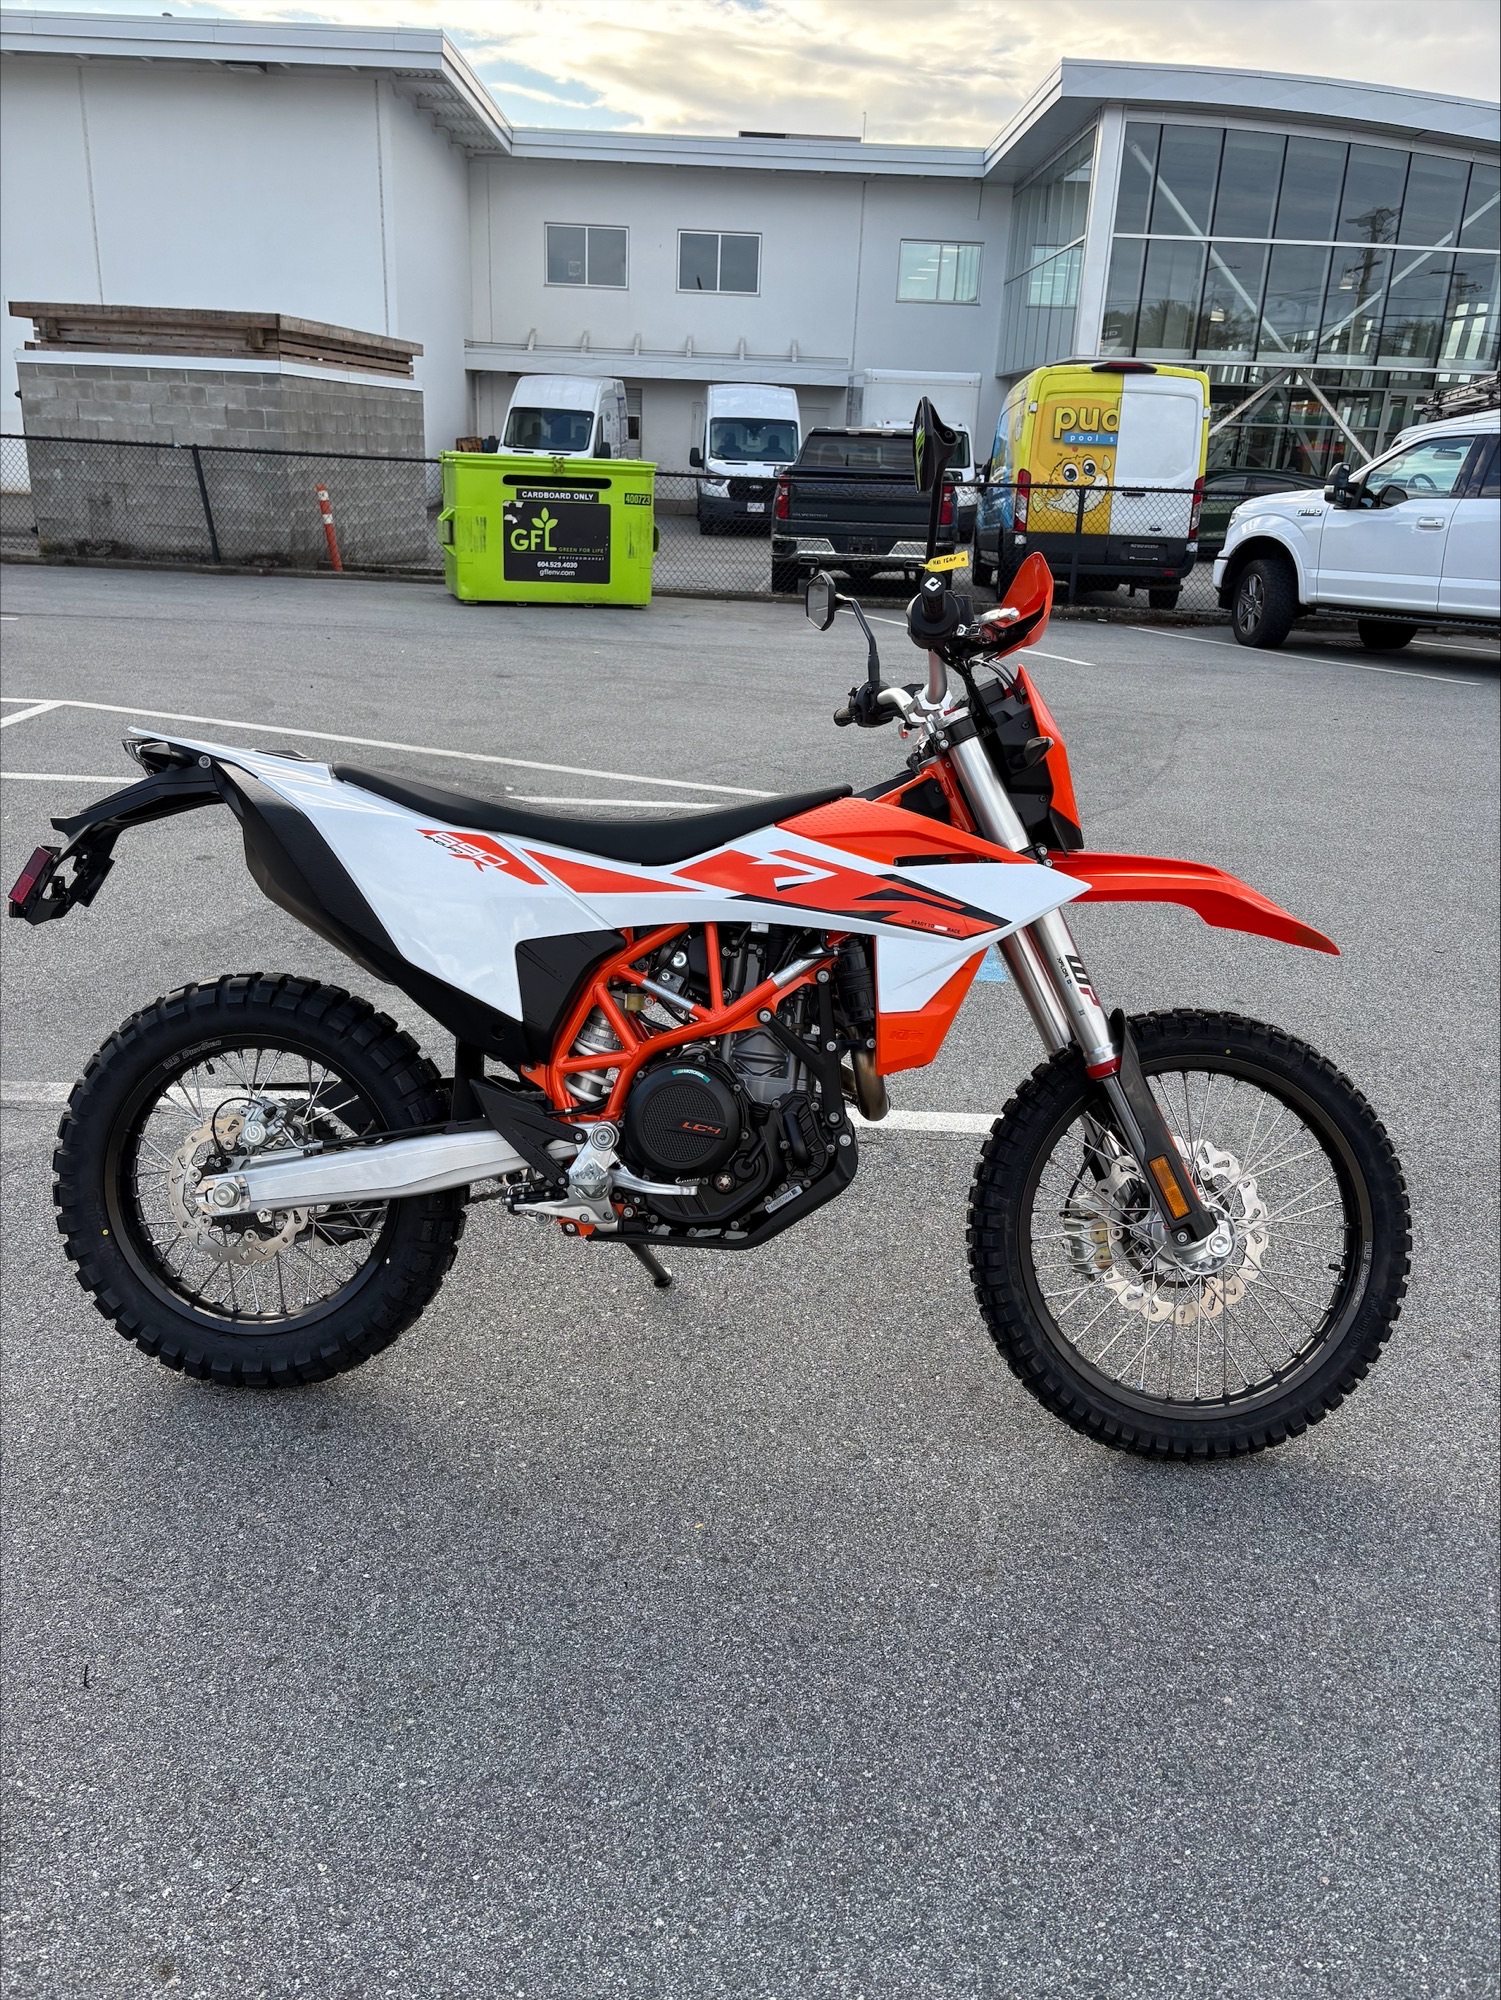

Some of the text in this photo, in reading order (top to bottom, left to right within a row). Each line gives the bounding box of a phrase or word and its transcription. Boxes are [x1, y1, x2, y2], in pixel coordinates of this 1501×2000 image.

[1070, 434, 1099, 442] pool
[522, 491, 571, 500] CARDBOARD
[625, 494, 651, 505] 400723
[510, 519, 558, 551] GFL
[682, 1121, 721, 1134] LC4
